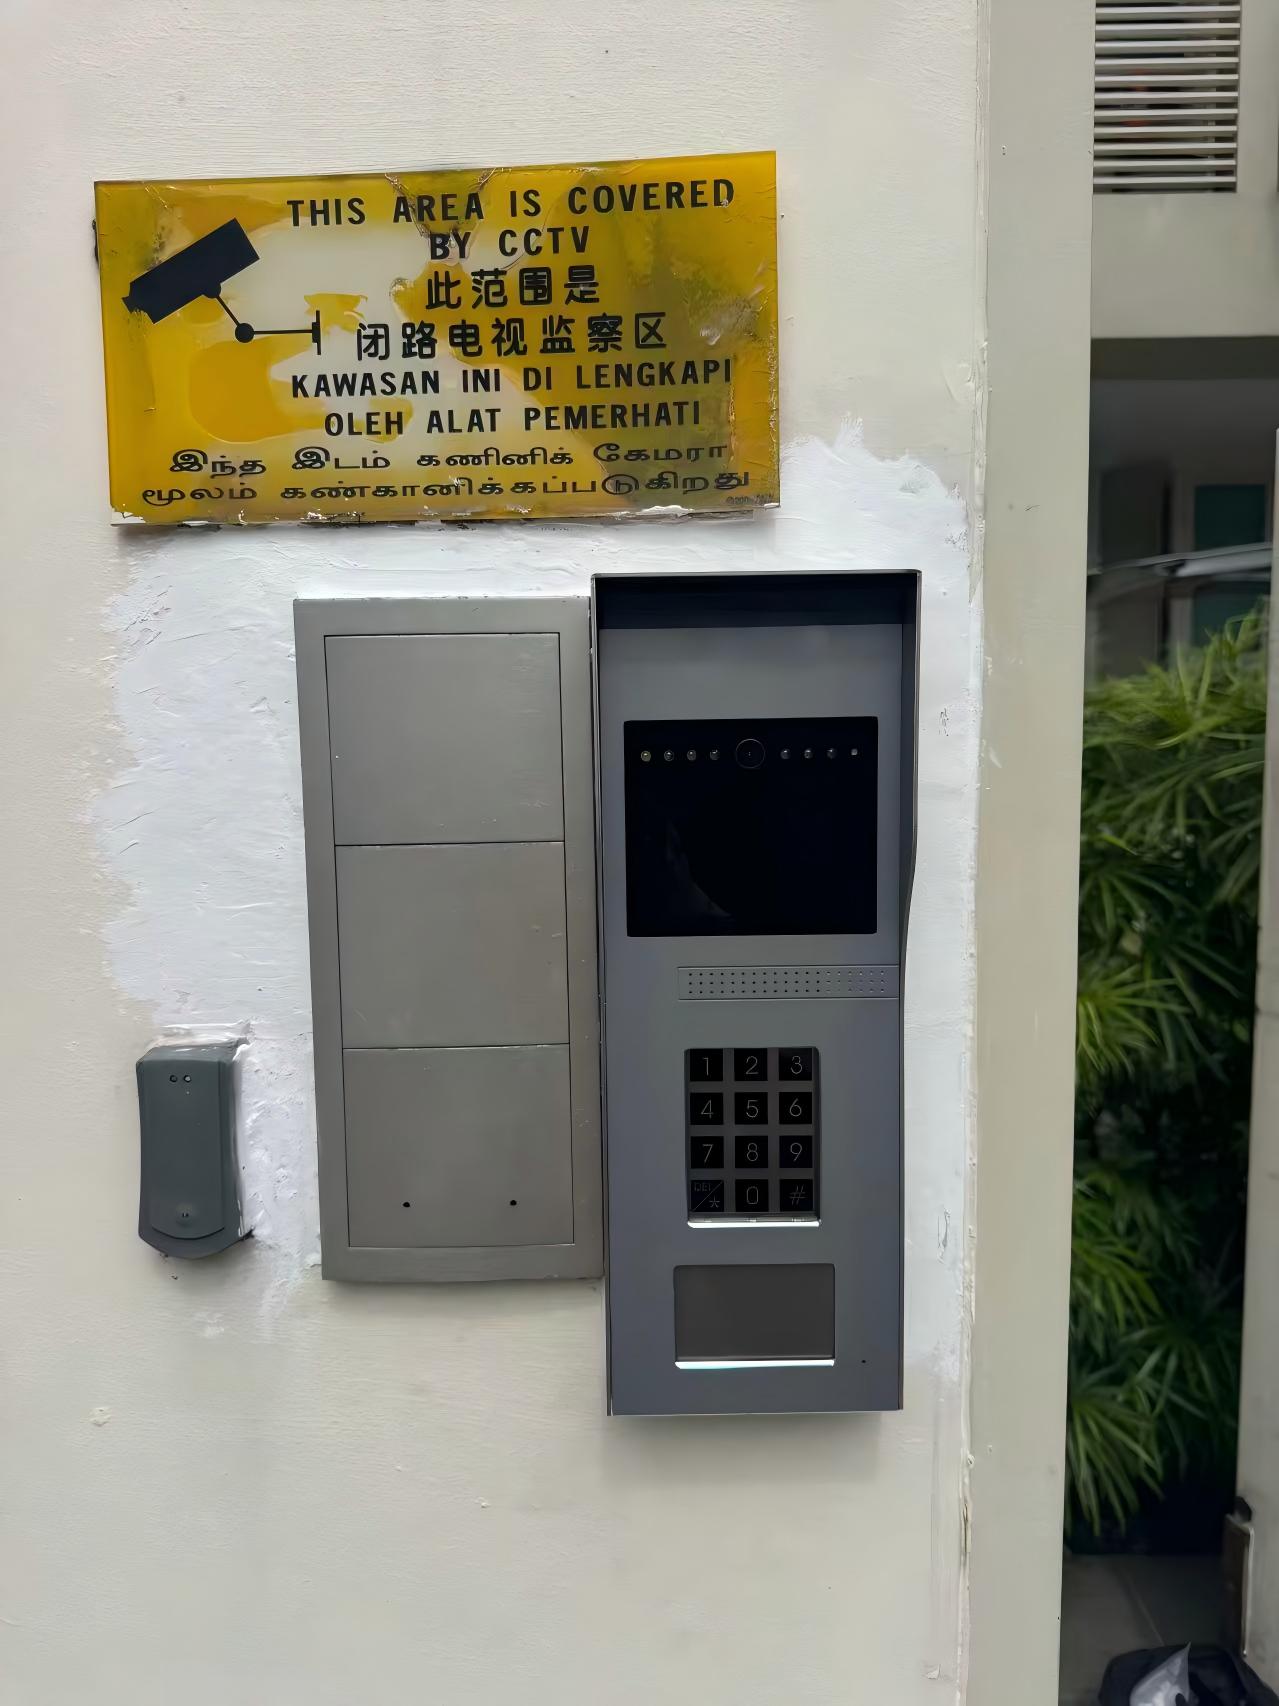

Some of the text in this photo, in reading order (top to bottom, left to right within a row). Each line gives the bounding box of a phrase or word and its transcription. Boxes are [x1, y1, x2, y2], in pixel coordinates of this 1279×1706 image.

[287, 178, 735, 227] THIS AREA IS COVERED
[430, 226, 590, 260] BY CCTV
[425, 264, 600, 310] 此范围是
[356, 311, 667, 361] 闭路电视监察区
[291, 358, 731, 399] KAWASAN INI DI LENGKAPI
[324, 400, 700, 437] OLEH ALAT PEMERHATI
[169, 448, 267, 479] இந்த
[291, 446, 391, 471] இடம்
[593, 442, 728, 463] கேமரா
[141, 482, 258, 507] மூலம்
[703, 1057, 710, 1076] 1
[745, 1055, 759, 1075] 2
[790, 1055, 803, 1075] 3
[701, 1099, 714, 1119] 4
[746, 1099, 759, 1118] 5
[789, 1098, 802, 1117] 6
[702, 1143, 714, 1163] 7
[746, 1142, 759, 1162] 8
[790, 1142, 803, 1162] 9
[746, 1186, 759, 1205] 0
